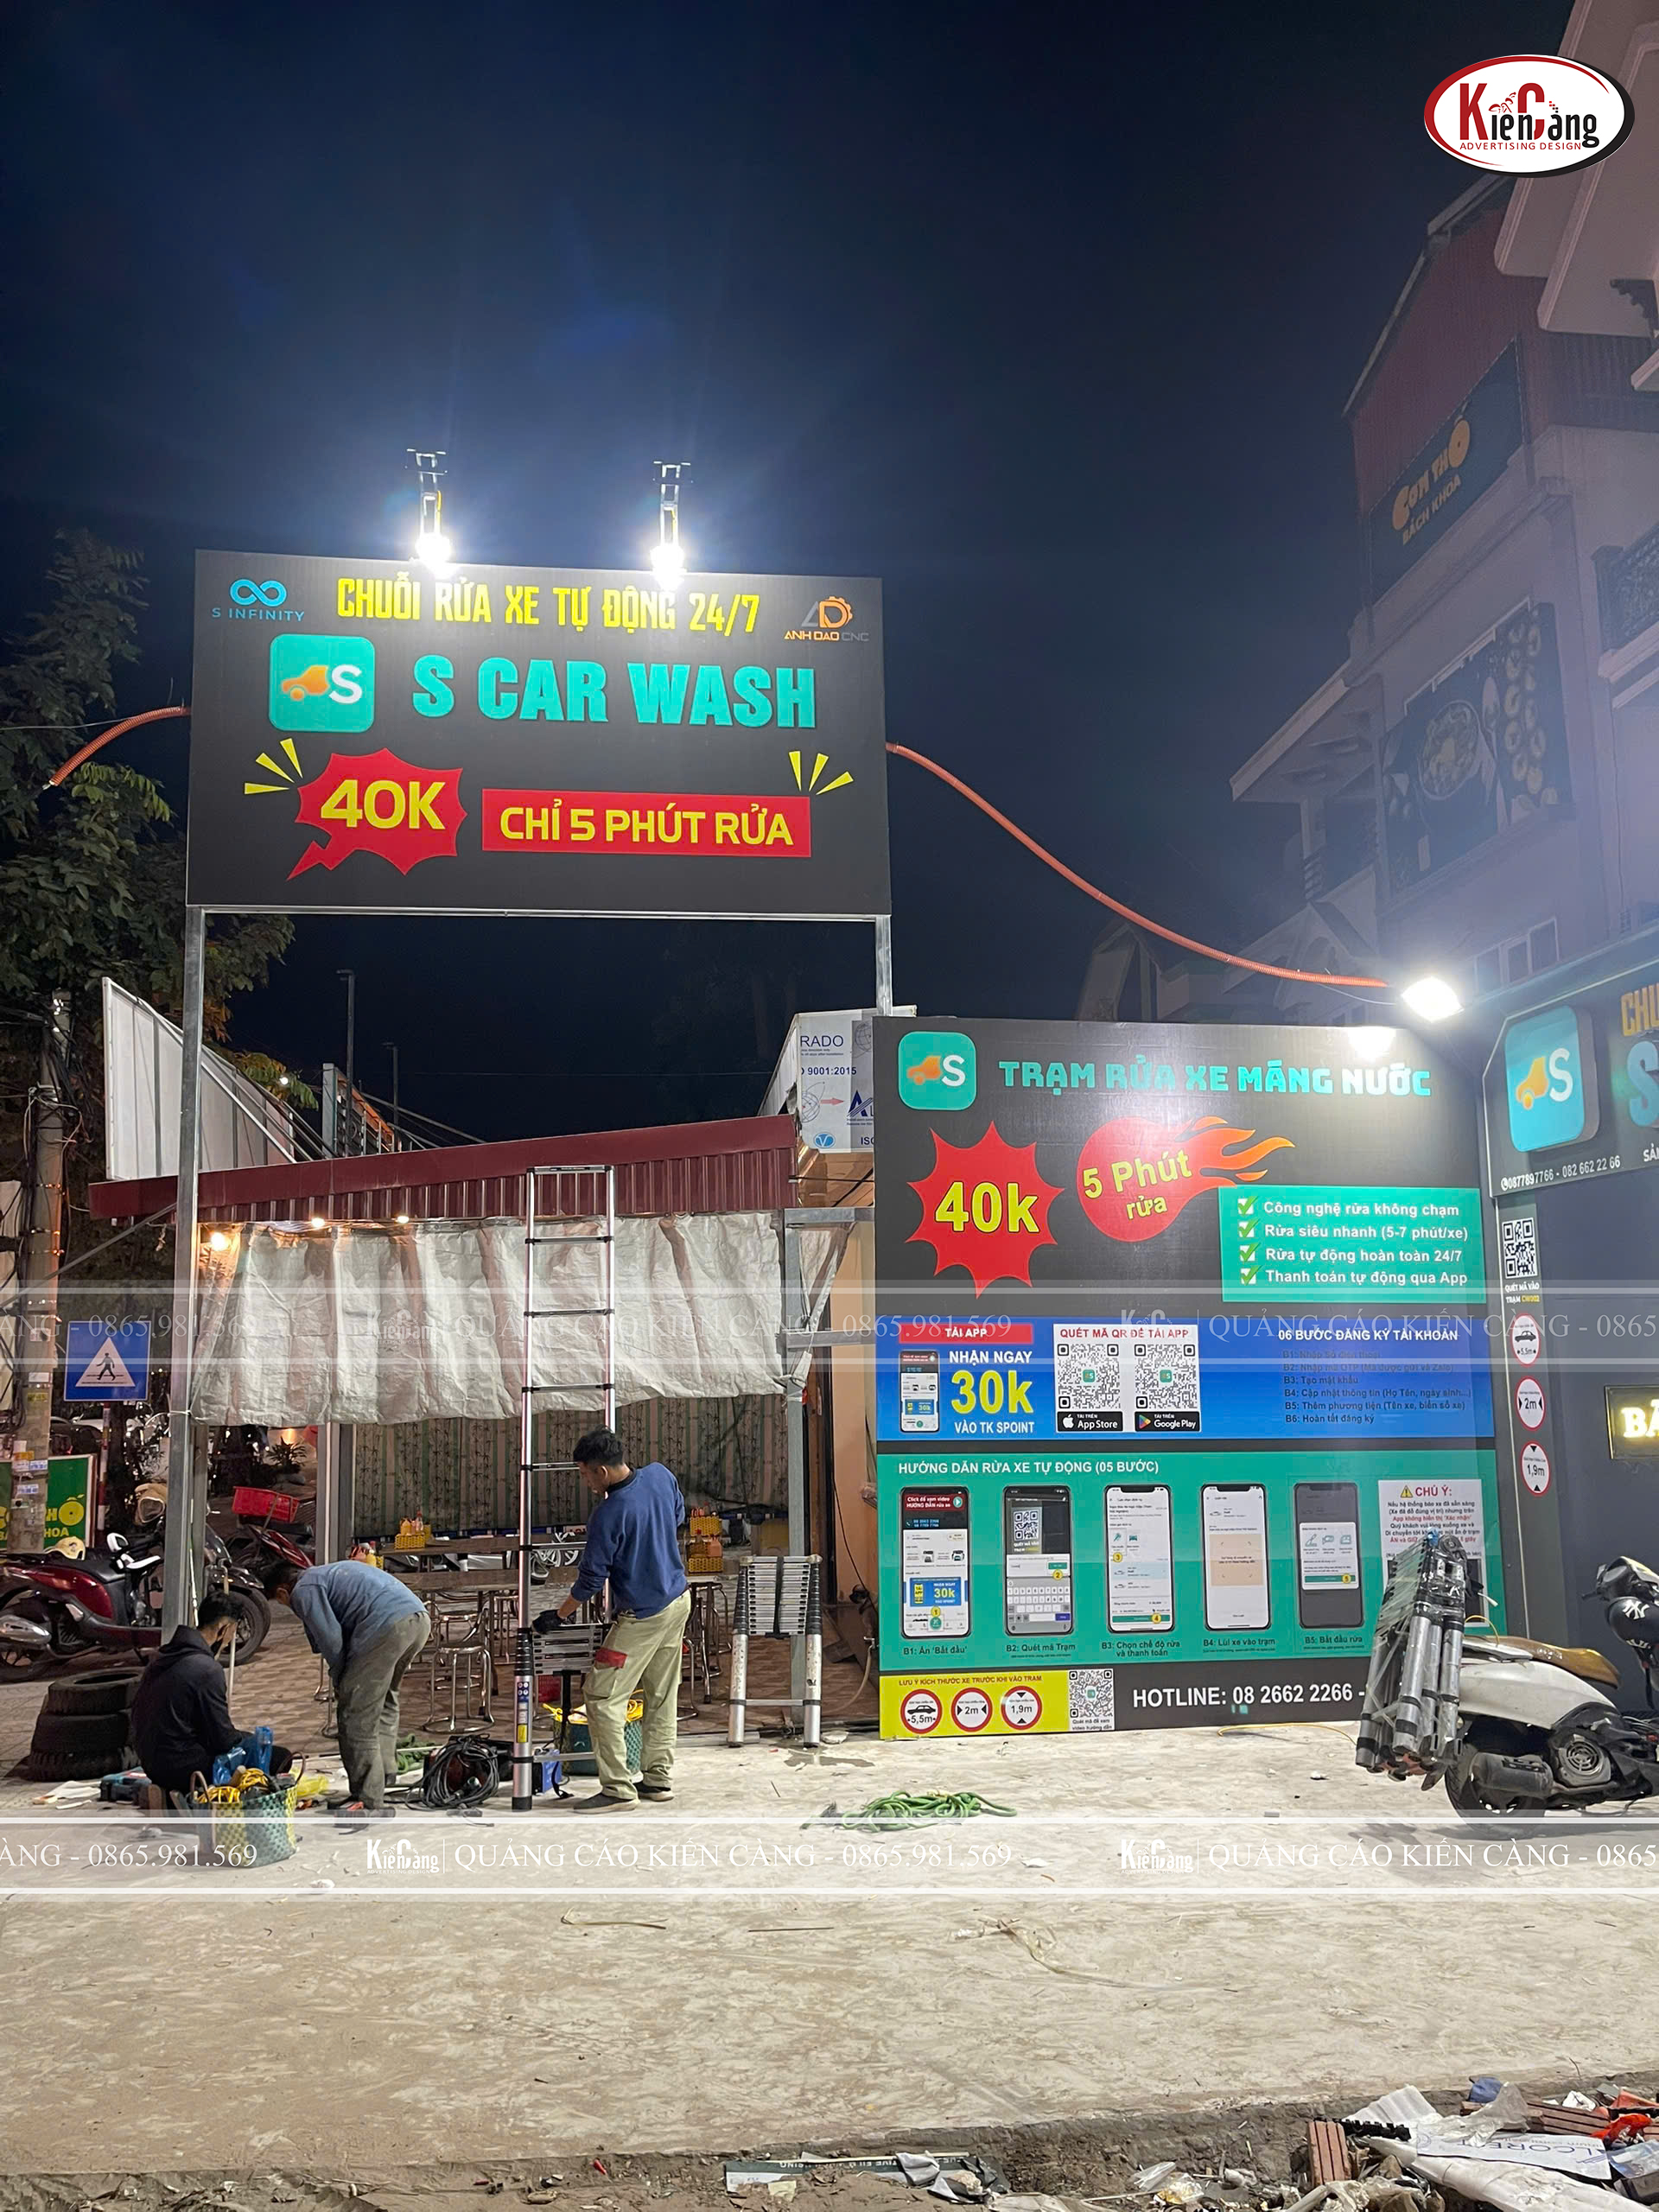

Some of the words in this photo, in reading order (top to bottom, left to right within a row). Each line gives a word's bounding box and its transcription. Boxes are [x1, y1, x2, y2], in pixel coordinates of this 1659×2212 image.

[337, 571, 420, 620] CHUỖI
[435, 576, 492, 623] RỬA
[505, 586, 539, 625] XE
[552, 586, 591, 632] TỰ
[601, 585, 676, 634] ĐỘNG
[689, 593, 760, 637] 24/7
[212, 607, 220, 618] S
[229, 608, 304, 622] INFINITY
[784, 630, 811, 640] ANH
[842, 632, 869, 641] CNC
[328, 664, 363, 704] S
[412, 654, 454, 718] S
[477, 657, 608, 723] CAR
[627, 662, 816, 728] WASH
[321, 779, 446, 830] 40K
[499, 798, 561, 842] CHỈ
[571, 808, 594, 842] 5
[606, 801, 706, 845] PHÚT
[715, 802, 794, 846] RỬA
[808, 1066, 857, 1076] 9001:2015
[942, 1054, 966, 1087] S
[999, 1061, 1096, 1096] TRẠM
[1105, 1054, 1176, 1091] RỬA
[1185, 1065, 1229, 1091] XE
[1341, 1062, 1431, 1096] NƯỚC
[1549, 1047, 1573, 1103] S
[1083, 1168, 1103, 1199] 5
[1111, 1149, 1192, 1192] Phút
[1562, 1164, 1577, 1178] 082
[1580, 1161, 1594, 1174] 662
[1597, 1158, 1607, 1171] 22
[1610, 1155, 1620, 1168] 66
[934, 1181, 1039, 1234] 40k
[1126, 1195, 1167, 1220] rửa
[1264, 1201, 1300, 1217] Công
[1306, 1202, 1339, 1217] nghệ
[1345, 1203, 1370, 1215] rửa
[1375, 1203, 1417, 1218] không
[1421, 1205, 1459, 1218] chạm
[1265, 1224, 1294, 1237] Rửa
[1299, 1225, 1328, 1237] siêu
[1333, 1225, 1376, 1238] nhanh
[1382, 1226, 1407, 1241] (5-7
[1412, 1226, 1468, 1242] phút/xe)
[1266, 1249, 1294, 1261] Rửa
[1300, 1249, 1315, 1263] tự
[1320, 1249, 1356, 1263] động
[1360, 1249, 1395, 1262] hoàn
[1399, 1249, 1429, 1262] toàn
[1433, 1250, 1462, 1262] 24/7
[1265, 1269, 1310, 1283] Thanh
[1315, 1270, 1345, 1283] toán
[1351, 1272, 1367, 1286] tự
[1370, 1271, 1406, 1286] động
[1410, 1274, 1436, 1286] qua
[1440, 1272, 1468, 1286] App
[944, 1326, 964, 1338] TẢI
[966, 1328, 988, 1338] APP
[1059, 1327, 1089, 1338] QUÉT
[1092, 1327, 1109, 1338] MÃ
[1111, 1329, 1127, 1338] QR
[1148, 1328, 1165, 1338] TẢI
[1167, 1329, 1189, 1338] APP
[1278, 1330, 1293, 1340] 06
[1295, 1328, 1332, 1341] BƯỚC
[1335, 1328, 1370, 1341] ĐĂNG
[1374, 1328, 1389, 1341] KÝ
[1393, 1328, 1412, 1341] TÀI
[949, 1350, 989, 1366] NHẬN
[994, 1351, 1033, 1364] NGAY
[950, 1370, 1034, 1414] 30k
[1524, 1398, 1537, 1410] 2m
[1077, 1420, 1096, 1430] App
[1096, 1420, 1118, 1428] Store
[1154, 1420, 1180, 1429] Google
[1181, 1420, 1197, 1429] Play
[1285, 1414, 1300, 1423] B6:
[1302, 1414, 1325, 1423] Hoàn
[954, 1420, 977, 1433] VÀO
[981, 1421, 994, 1433] TK
[996, 1421, 1034, 1434] SPOINT
[899, 1461, 948, 1474] HƯỚNG
[951, 1461, 979, 1474] DẪN
[982, 1461, 1010, 1474] RỬA
[1014, 1462, 1030, 1473] XE
[1034, 1462, 1052, 1476] TỰ
[1055, 1461, 1092, 1476] ĐỘNG
[1095, 1462, 1114, 1475] (05
[1116, 1459, 1159, 1475] BƯỚC)
[1527, 1465, 1545, 1478] 1,9m
[1415, 1484, 1439, 1497] CHÚ
[1441, 1484, 1452, 1497] Ý:
[1133, 1686, 1227, 1707] HOTLINE:
[1233, 1686, 1255, 1705] 08
[1260, 1685, 1304, 1704] 2662
[1309, 1683, 1353, 1702] 2266
[964, 1706, 979, 1715] 2m
[1011, 1705, 1033, 1715] 1,9m
[911, 1714, 933, 1725] 5,5m
